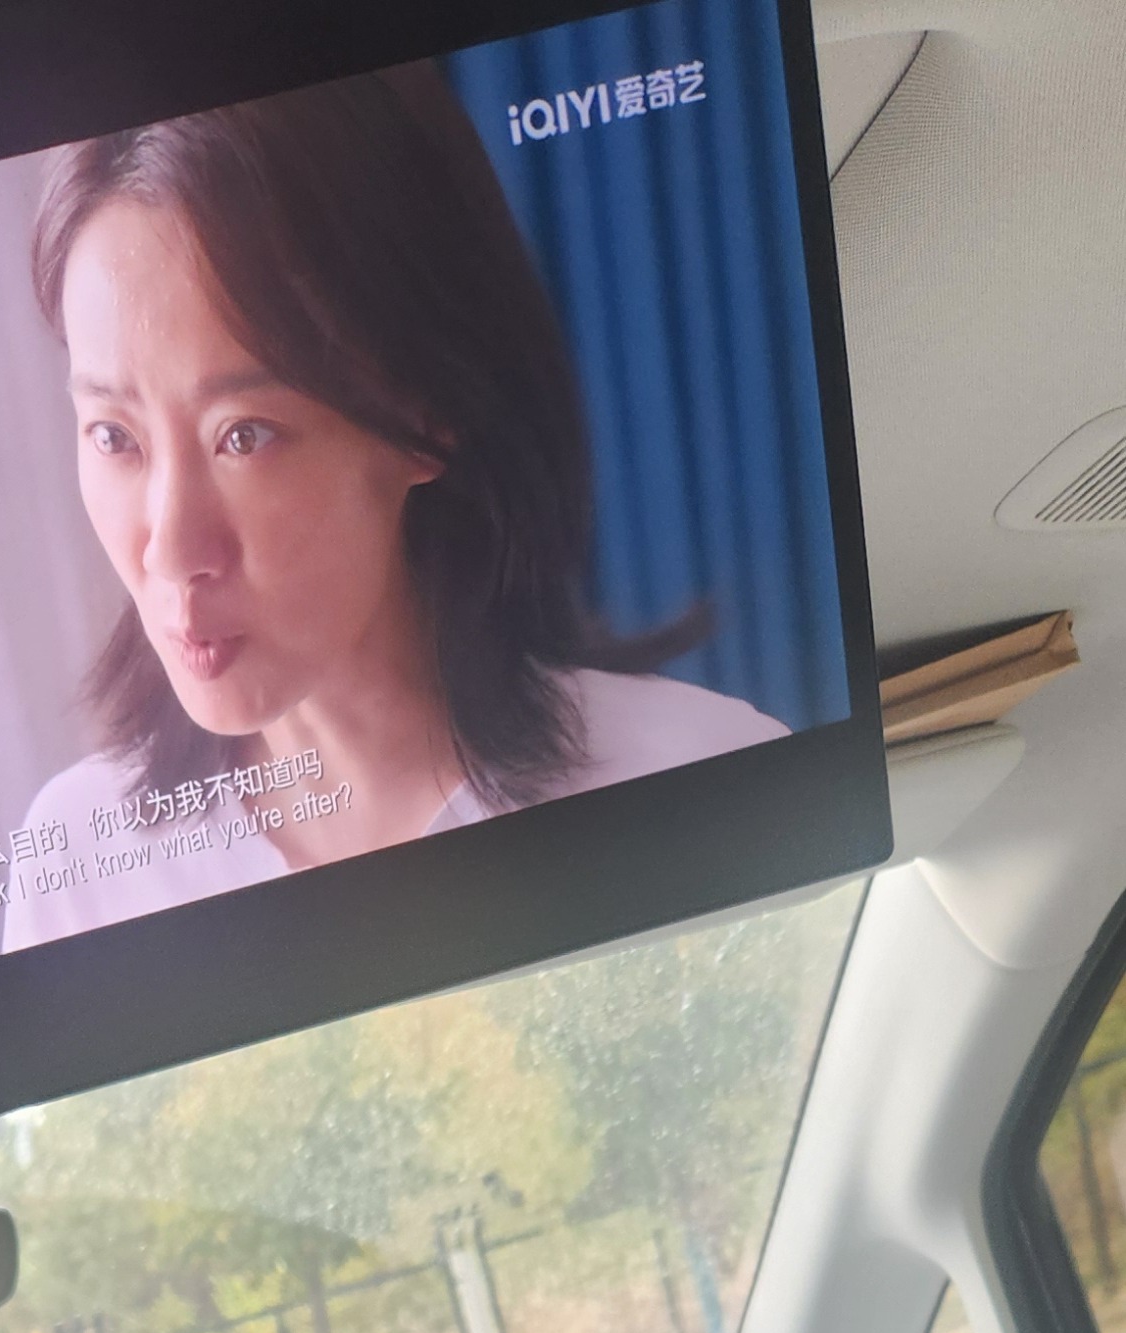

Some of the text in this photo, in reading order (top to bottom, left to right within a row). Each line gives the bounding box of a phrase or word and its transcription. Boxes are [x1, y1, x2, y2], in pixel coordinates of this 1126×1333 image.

[507, 60, 707, 146] iQIYI 爱奇艺
[18, 873, 27, 900] I
[35, 857, 89, 895] don't
[94, 843, 151, 880] know
[158, 822, 214, 860] what
[218, 805, 284, 850] you're
[292, 781, 353, 823] after?
[88, 748, 323, 841] 你以为我不知道吗
